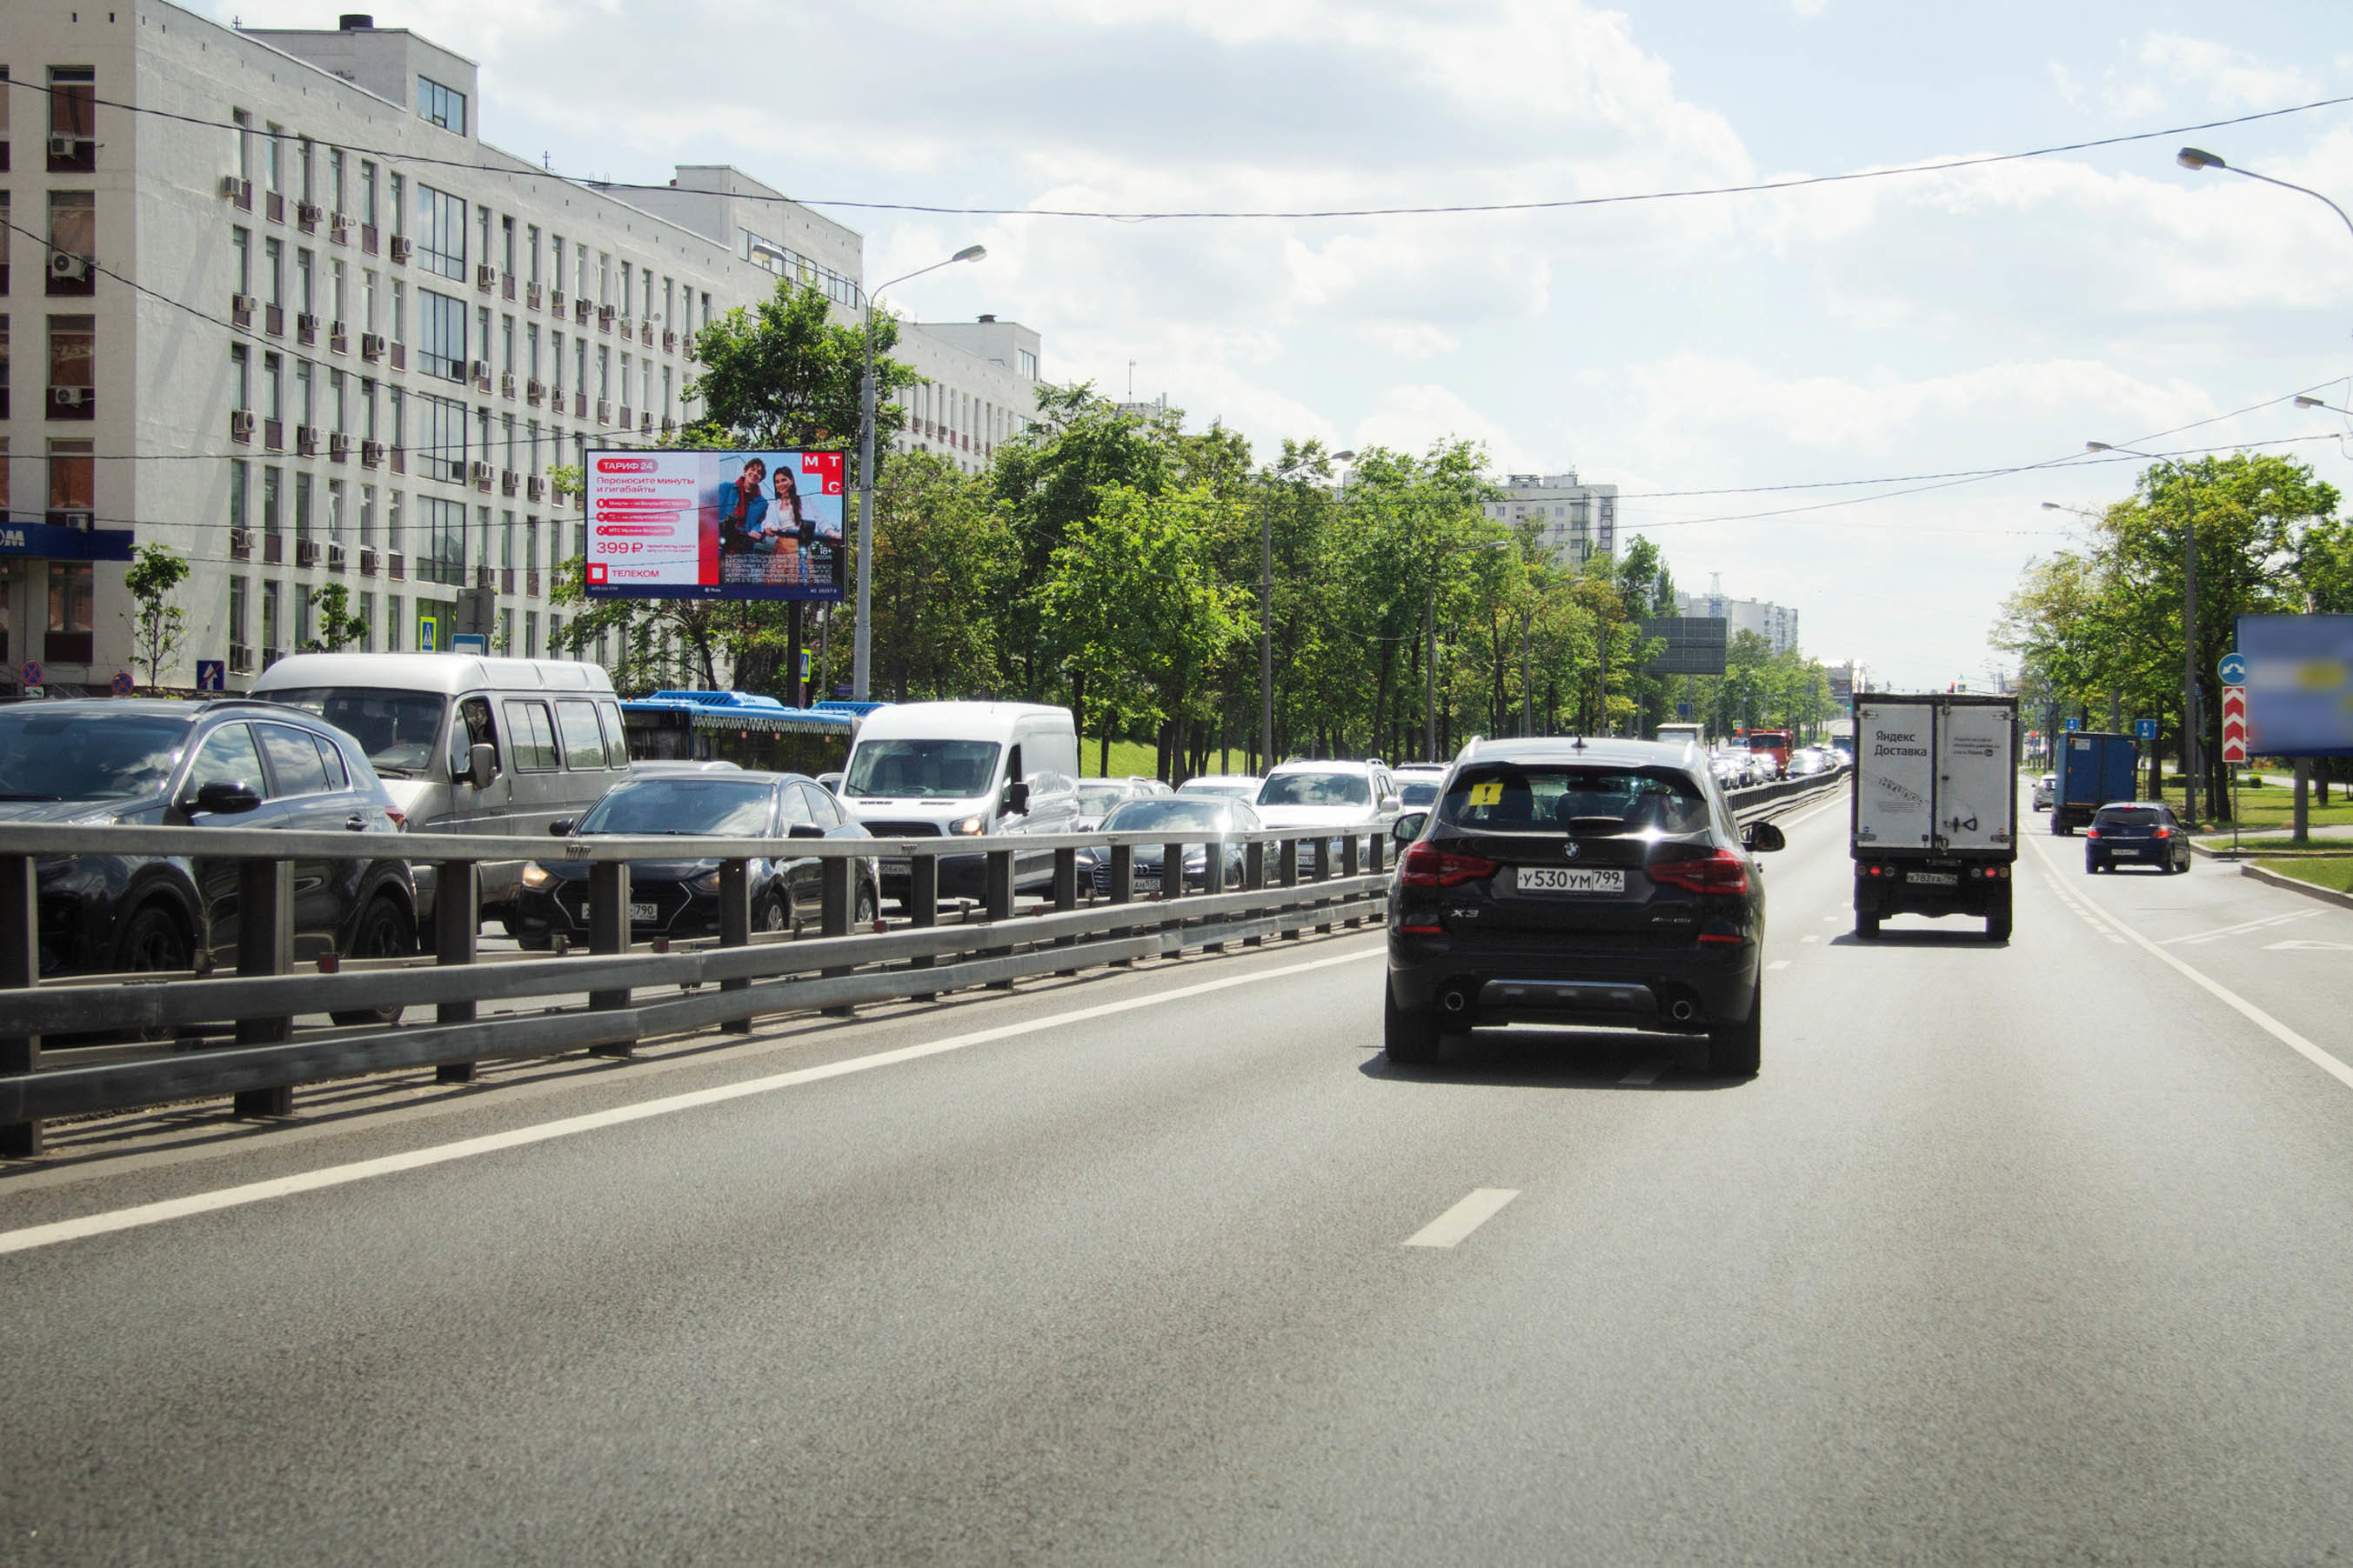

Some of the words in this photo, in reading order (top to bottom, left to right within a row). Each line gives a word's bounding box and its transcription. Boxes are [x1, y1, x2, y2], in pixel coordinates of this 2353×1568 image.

[597, 477, 655, 485] Переносите
[657, 477, 695, 487] минуты
[597, 542, 629, 554] 399
[612, 570, 659, 578] ТЕЛЕКОМ
[1875, 731, 1915, 743] Яндекс
[1875, 744, 1927, 757] Доставка
